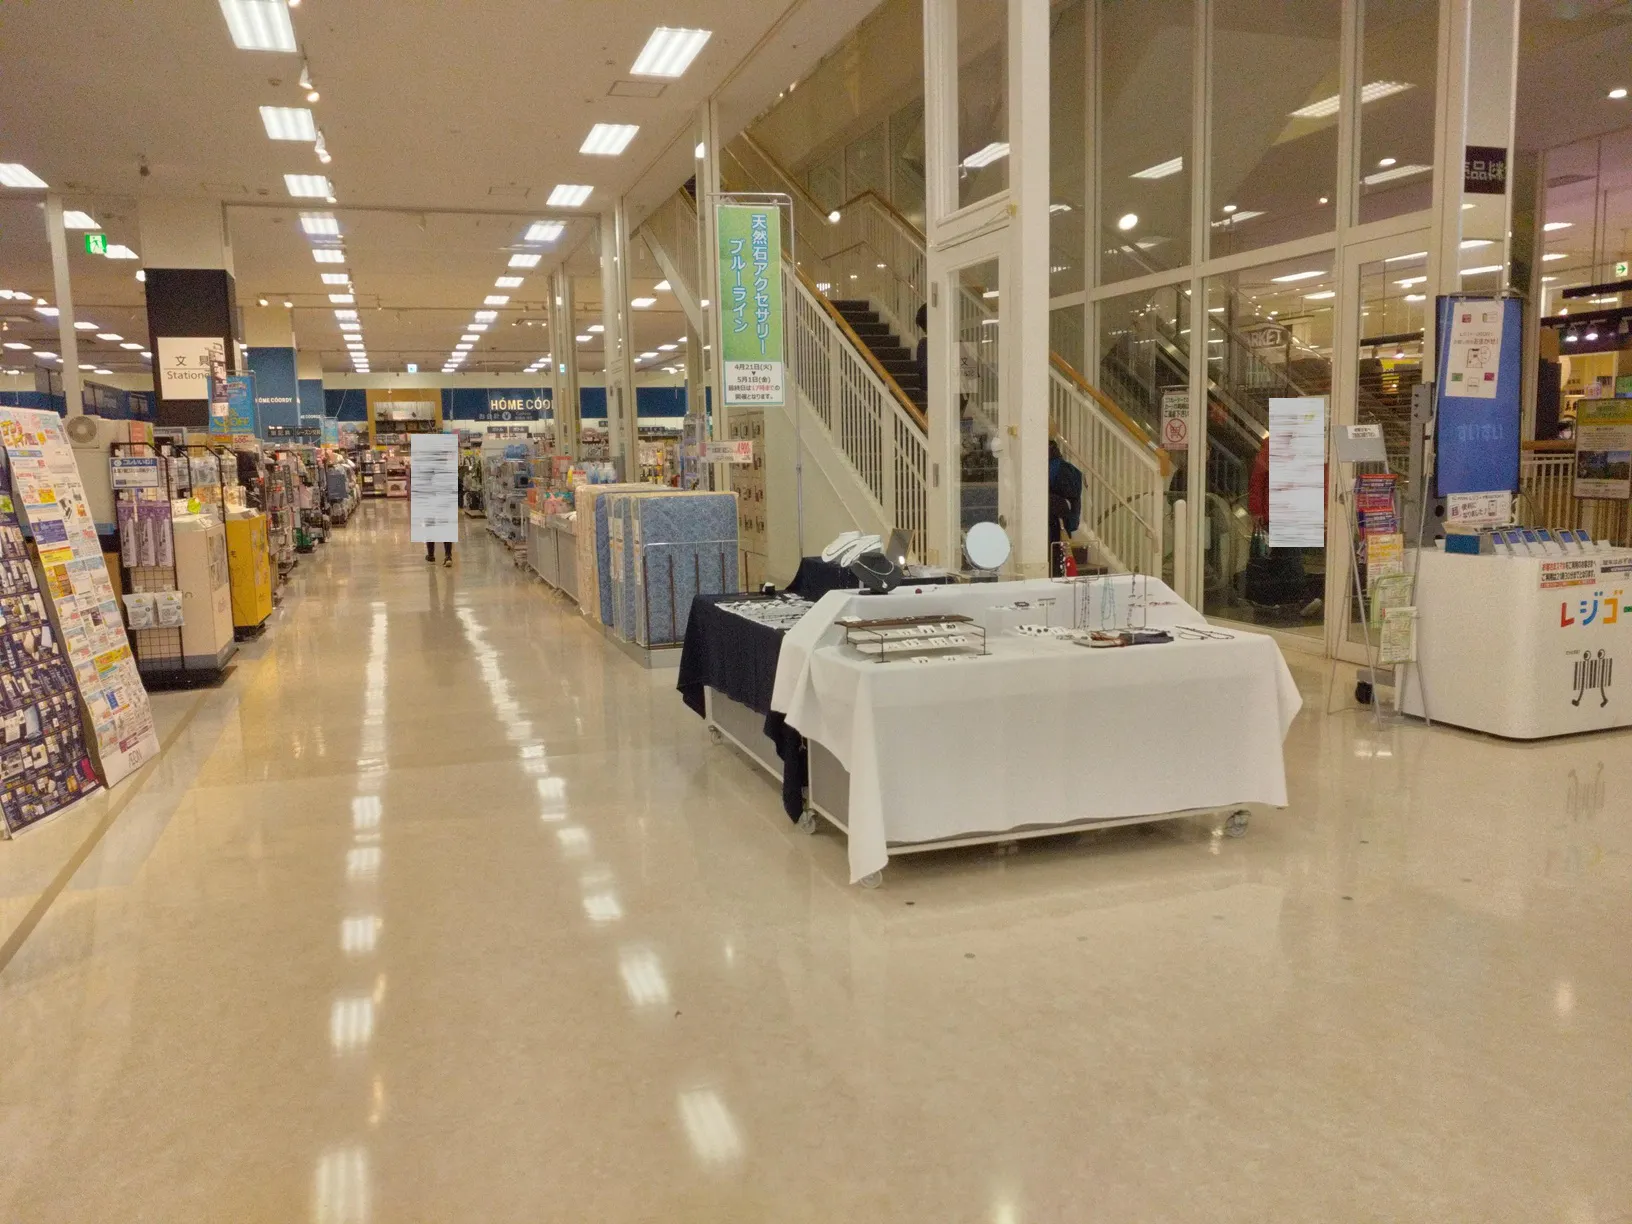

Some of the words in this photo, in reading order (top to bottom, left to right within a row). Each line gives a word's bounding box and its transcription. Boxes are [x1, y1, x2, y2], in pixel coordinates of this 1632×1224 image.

[730, 239, 748, 333] ブルーライン
[751, 214, 770, 355] 天然石アクセサリー
[167, 370, 210, 379] Statione
